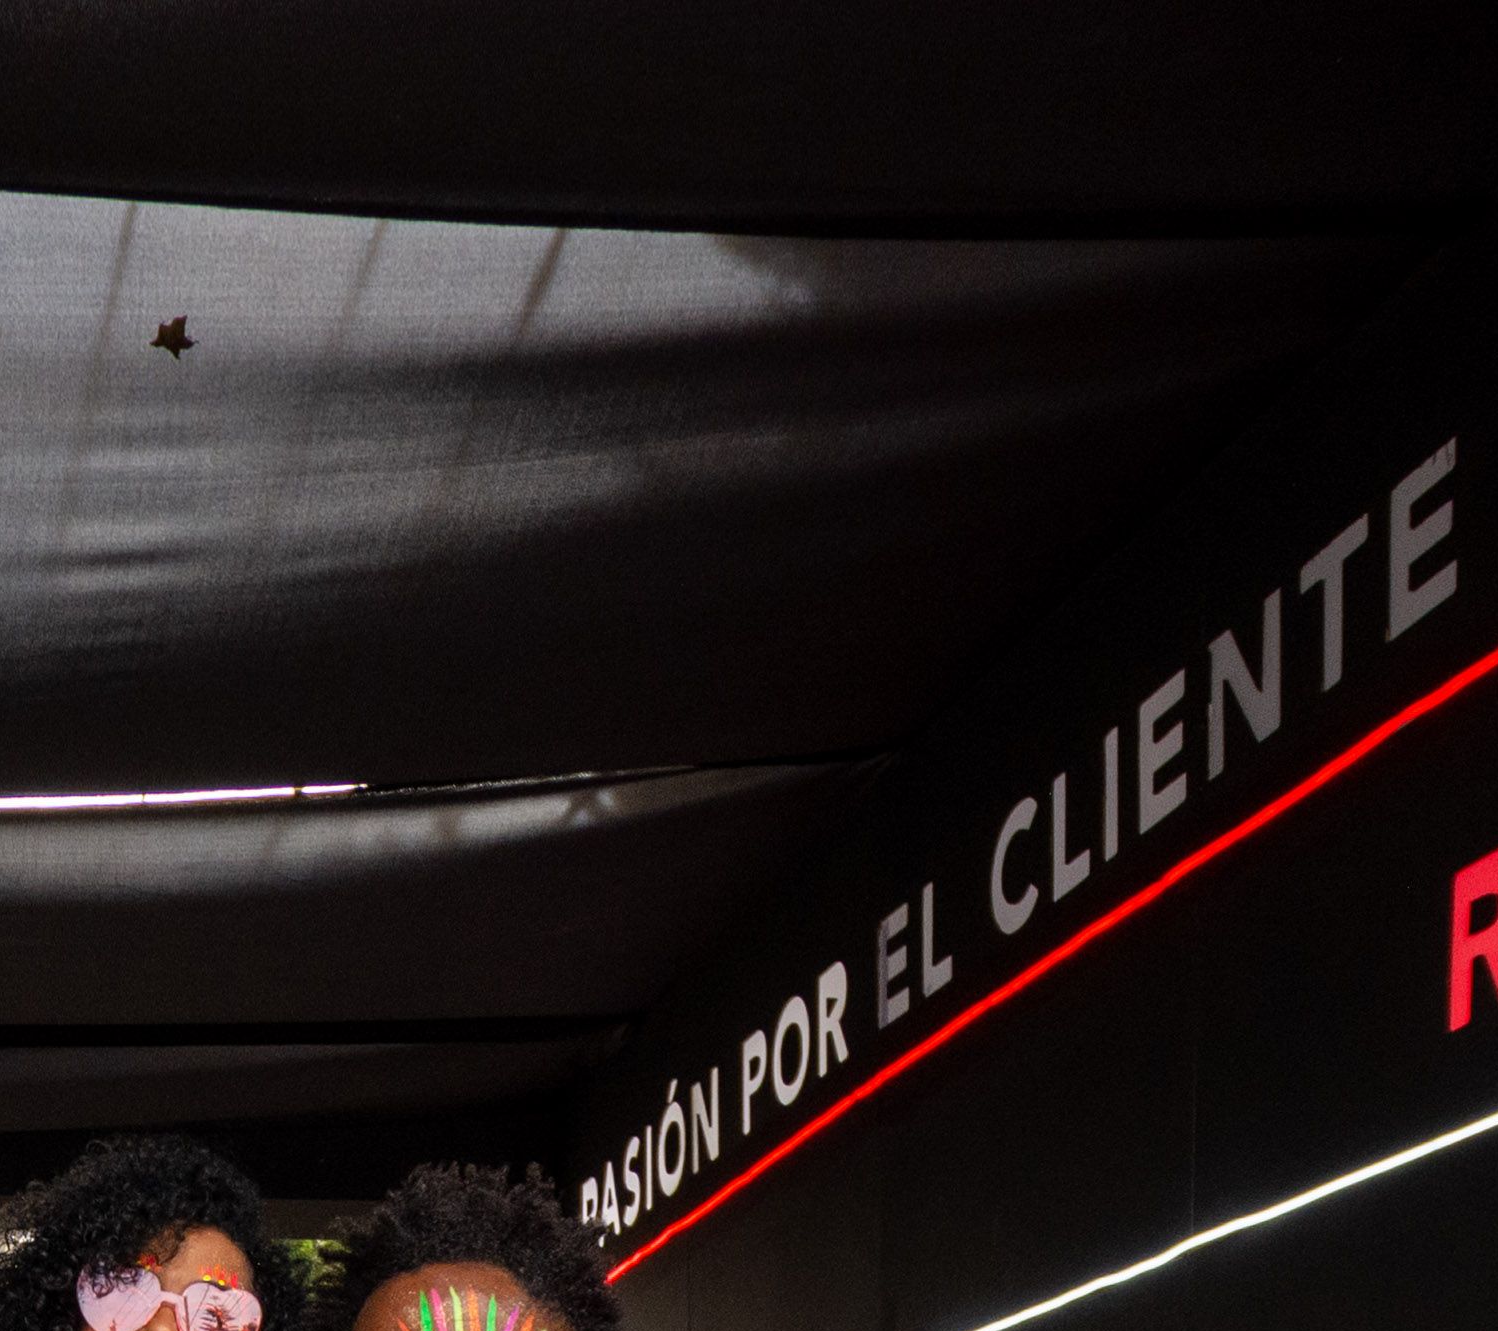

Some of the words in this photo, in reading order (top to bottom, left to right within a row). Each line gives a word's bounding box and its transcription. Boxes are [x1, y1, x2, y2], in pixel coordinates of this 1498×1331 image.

[581, 1066, 720, 1248] PASIÓN
[742, 960, 849, 1137] POR
[877, 881, 953, 1030] EL
[990, 436, 1459, 936] CLIENTE
